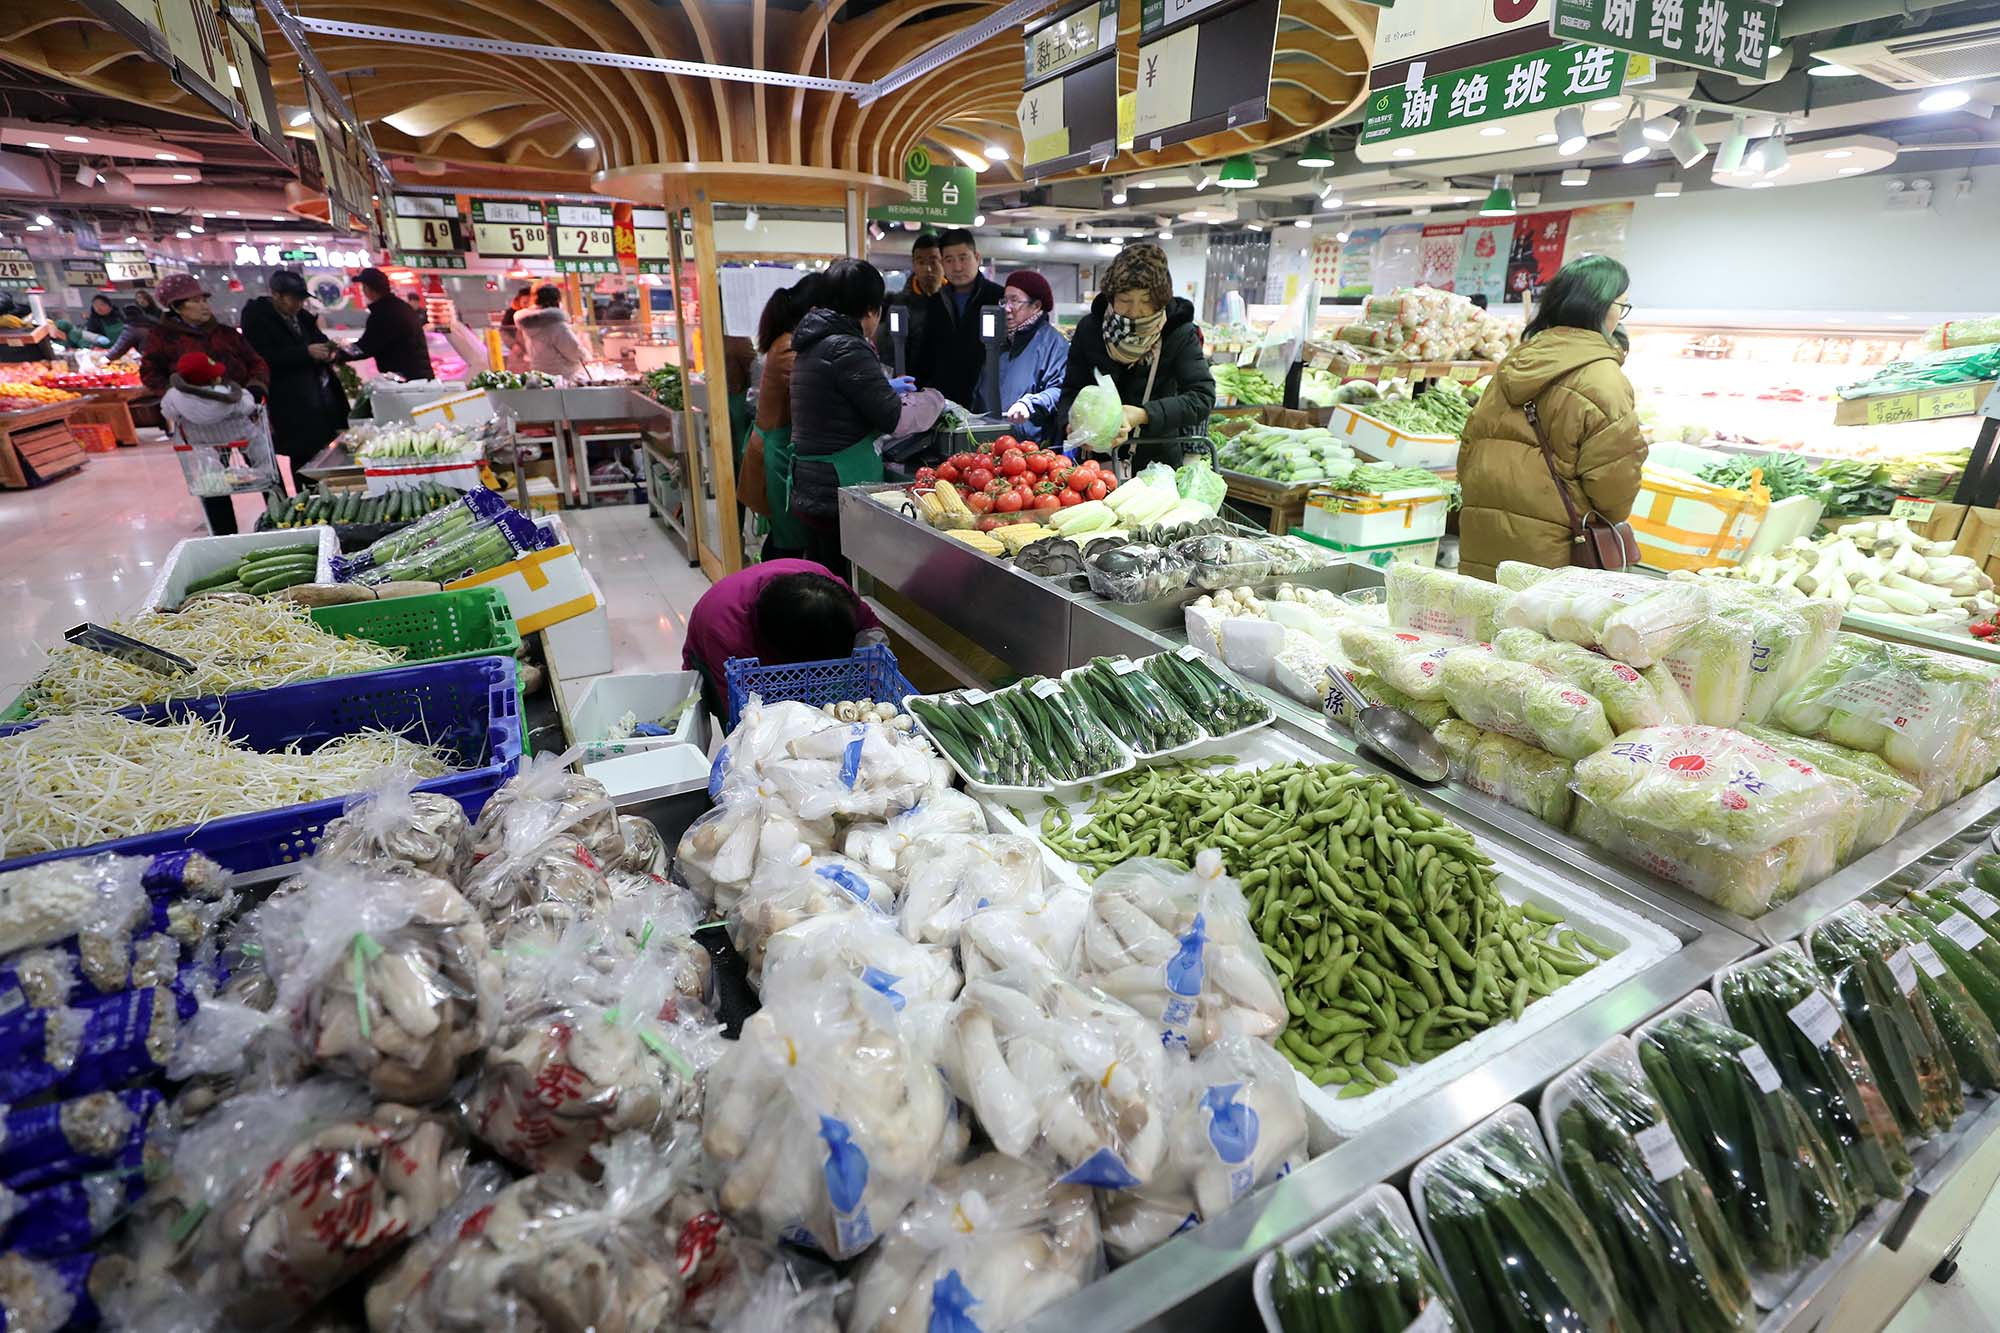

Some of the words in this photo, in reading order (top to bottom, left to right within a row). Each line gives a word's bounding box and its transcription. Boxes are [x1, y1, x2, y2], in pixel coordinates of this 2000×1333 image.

[1602, 0, 1766, 68] 谢绝挑选
[1400, 48, 1613, 129] 谢绝挑选
[888, 205, 924, 216] WEIGHING
[926, 207, 949, 217] TABLE
[909, 179, 960, 205] 重台
